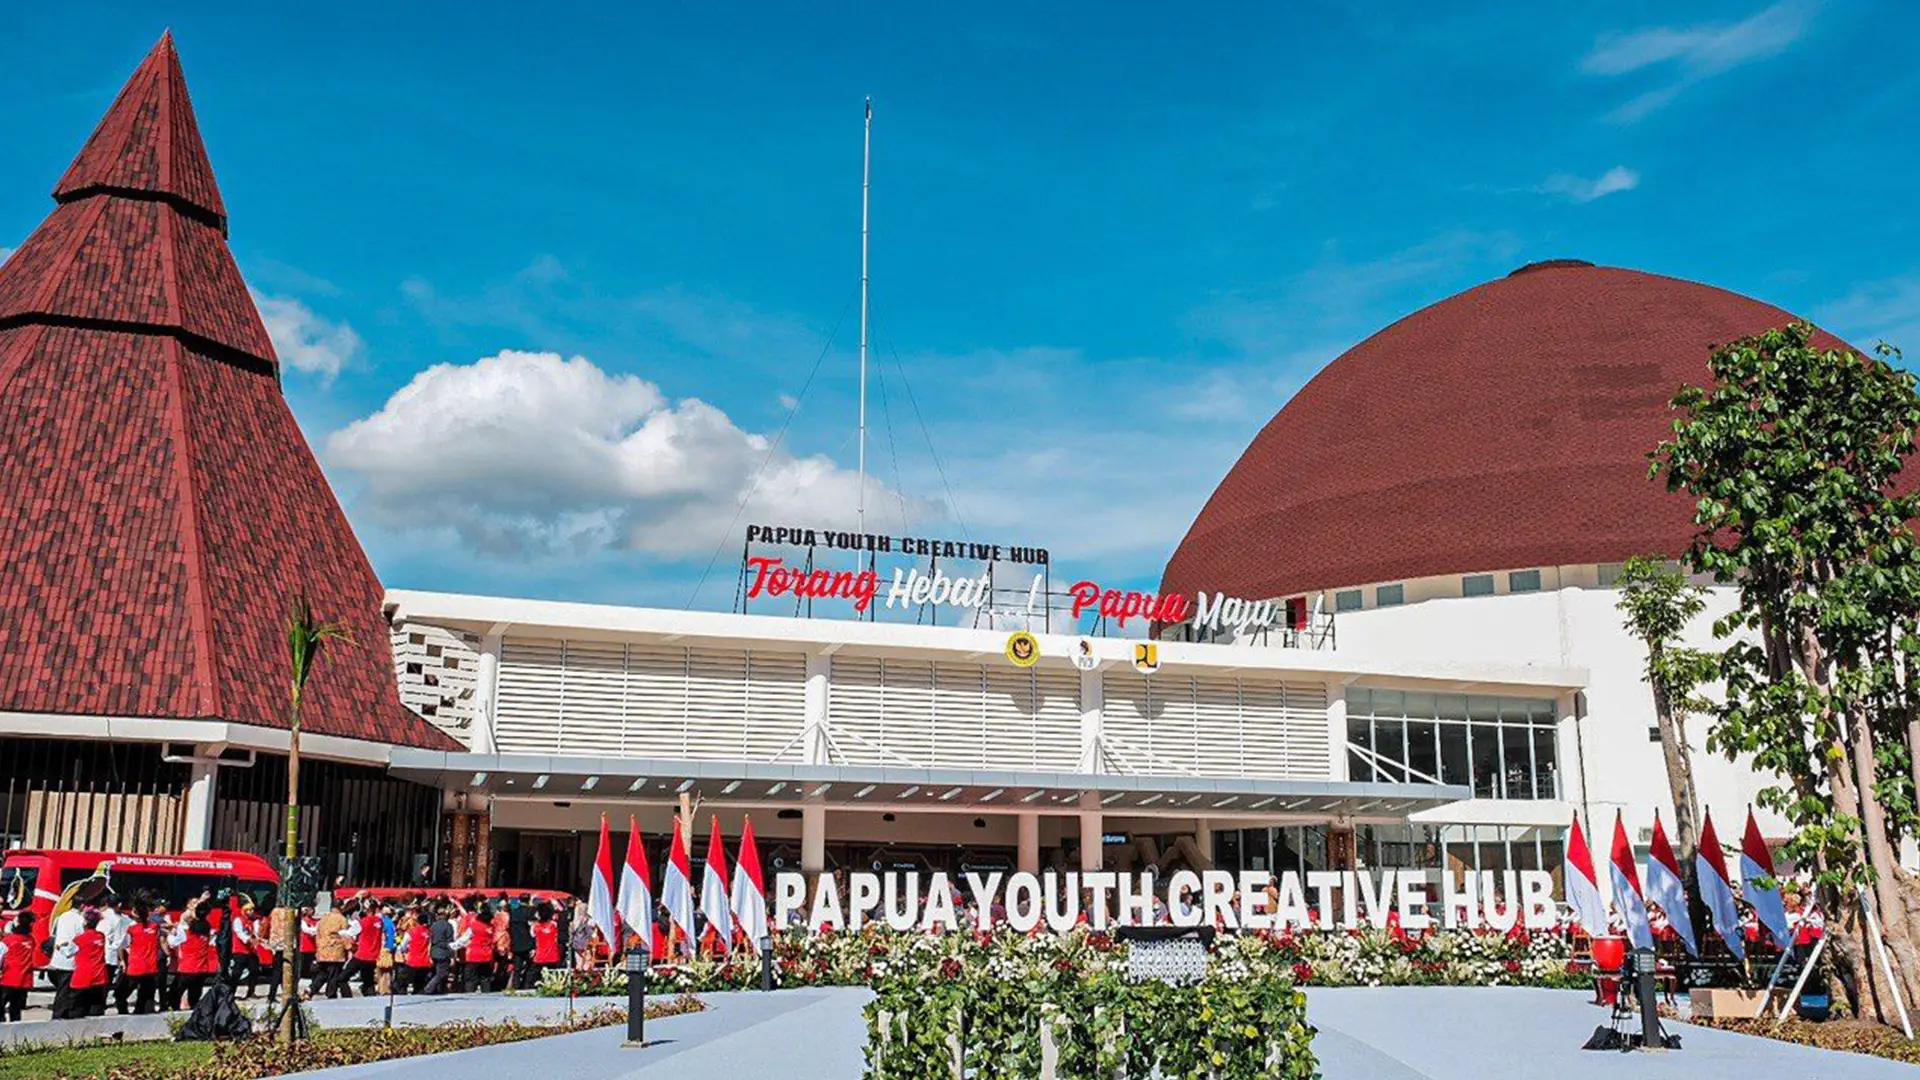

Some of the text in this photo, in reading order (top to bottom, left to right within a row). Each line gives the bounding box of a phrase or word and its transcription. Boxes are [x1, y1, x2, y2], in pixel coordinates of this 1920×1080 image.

[747, 525, 1049, 565] PAPUA YOUTH CREATIVE HUB
[747, 556, 880, 614] Torang
[1069, 580, 1187, 628] Papua
[116, 856, 233, 869] PAPUA YOUTH CREATIVE HUB
[775, 870, 1557, 932] PAPUA YOUTH CREATIVE HUB
